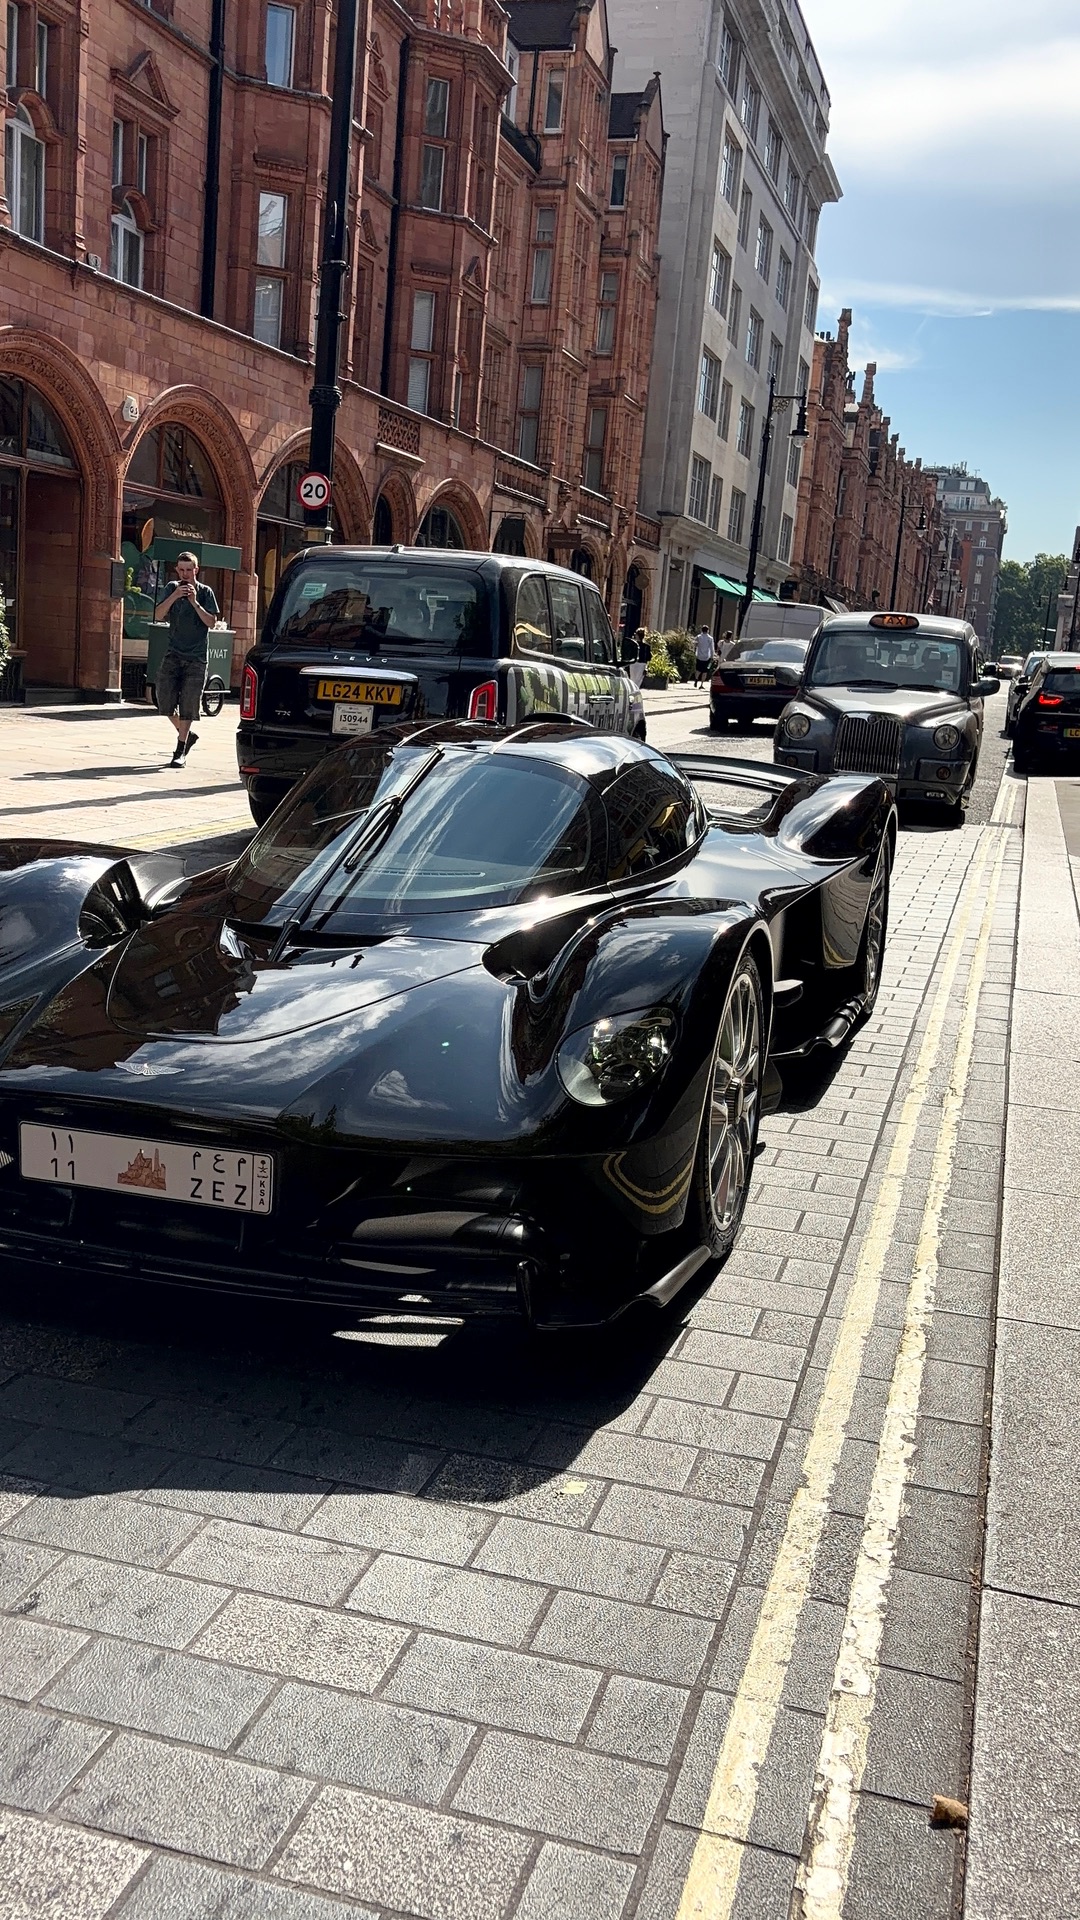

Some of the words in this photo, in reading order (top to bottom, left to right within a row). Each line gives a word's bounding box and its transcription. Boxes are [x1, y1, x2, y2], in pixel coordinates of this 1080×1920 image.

[303, 483, 326, 499] 20
[209, 648, 228, 659] YNAT
[333, 654, 388, 663] LEVC
[322, 684, 361, 700] LG24
[364, 686, 395, 702] KKV
[339, 714, 368, 724] 130944
[50, 1157, 75, 1181] 11
[189, 1177, 248, 1206] ZEZ
